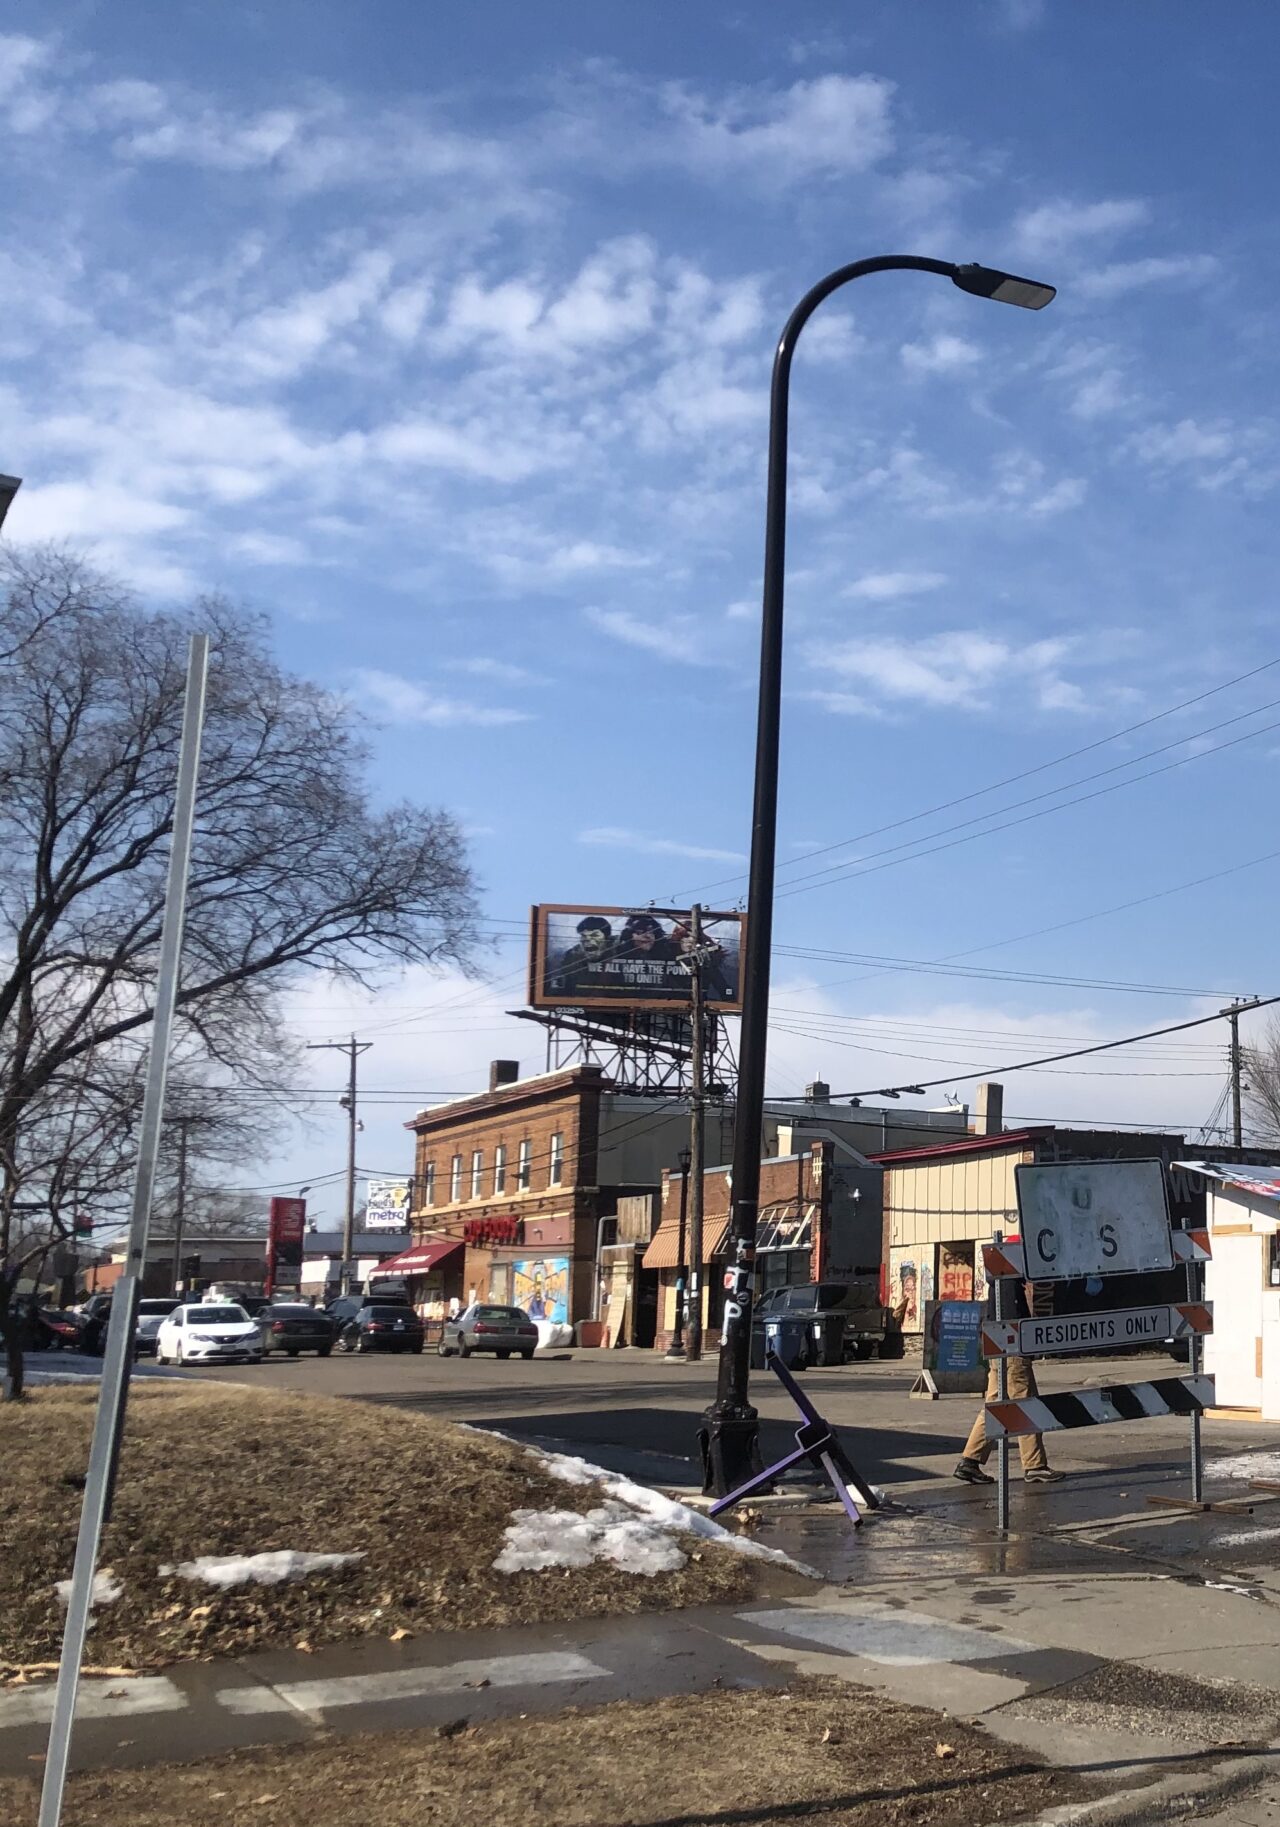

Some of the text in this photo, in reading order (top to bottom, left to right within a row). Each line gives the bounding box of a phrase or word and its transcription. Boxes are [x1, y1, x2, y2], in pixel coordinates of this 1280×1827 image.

[588, 962, 693, 976] WE ALL HAVE THE POWE
[624, 974, 663, 984] TO UNITE
[369, 1210, 404, 1220] metro
[944, 1272, 972, 1289] RIP
[1034, 1315, 1159, 1345] RESIDENTS ONLY
